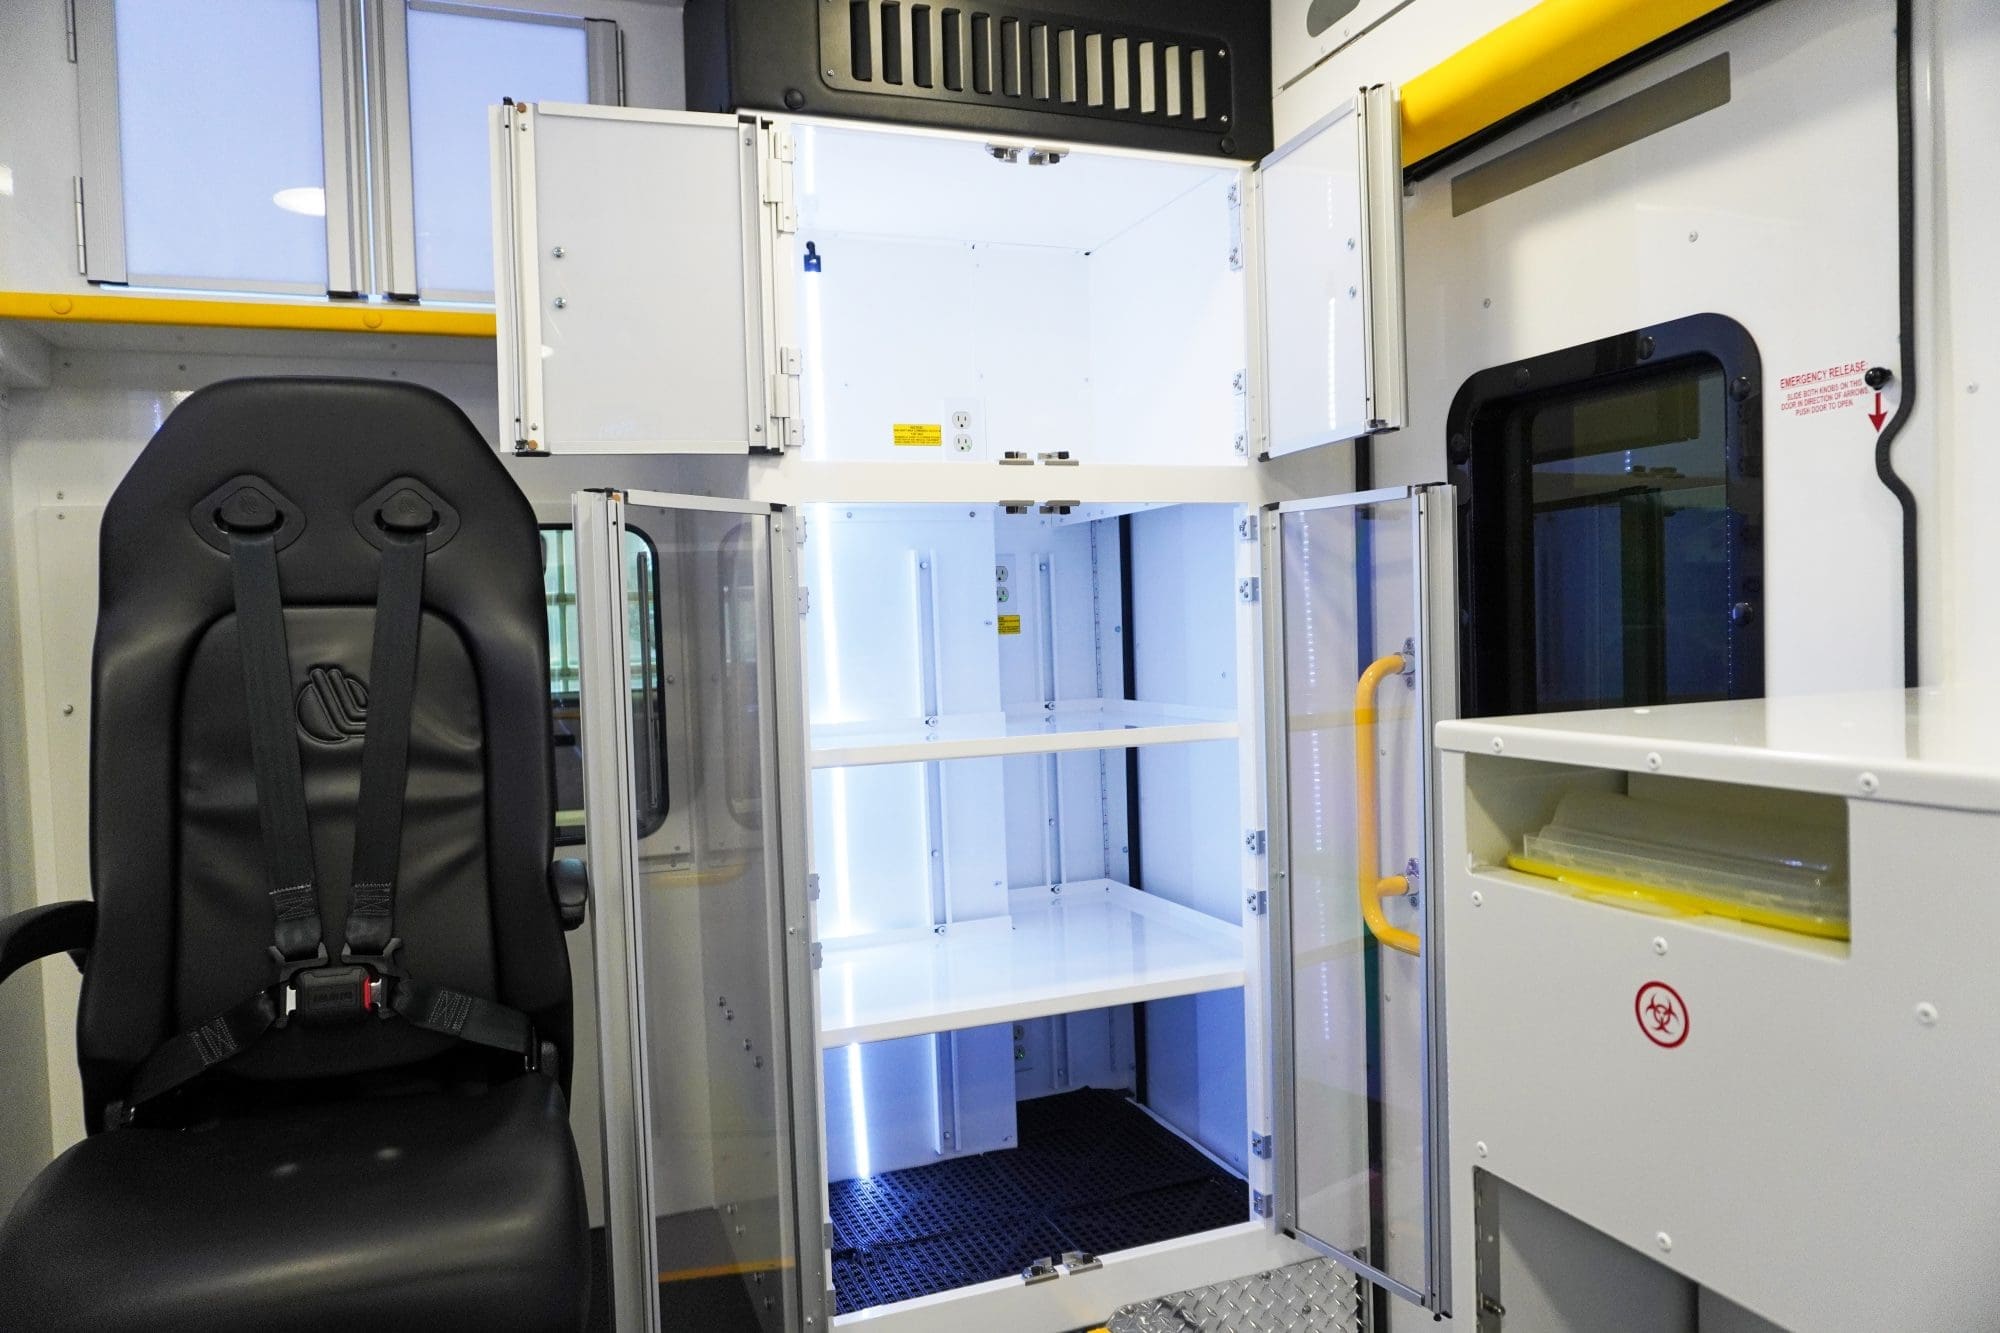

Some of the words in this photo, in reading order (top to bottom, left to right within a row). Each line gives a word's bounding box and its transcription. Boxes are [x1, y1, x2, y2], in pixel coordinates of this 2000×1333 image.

[1780, 370, 1826, 388] EMERGENCY
[1787, 390, 1801, 401] SLIDE
[1803, 388, 1818, 398] BOTH
[1820, 384, 1839, 394] KNOBS
[1840, 382, 1849, 391] ON
[1849, 379, 1862, 388] THIS
[1781, 401, 1796, 411] DOOR
[1798, 400, 1803, 408] IN
[1804, 395, 1833, 406] DIRECTION
[1834, 392, 1841, 400] OF
[1795, 408, 1810, 417] PUSH
[1811, 404, 1827, 414] DOOR
[1829, 401, 1836, 410] TO
